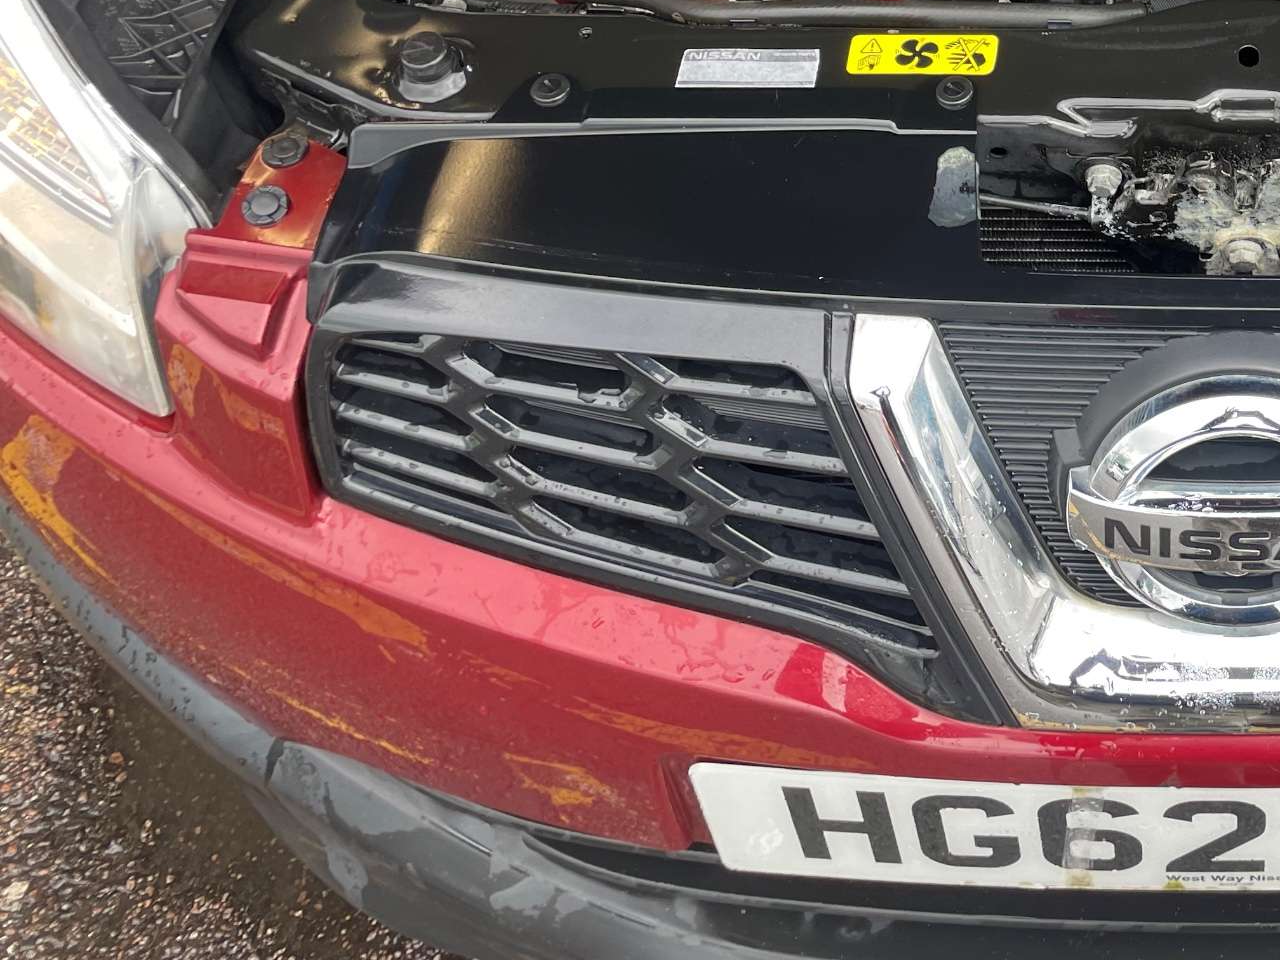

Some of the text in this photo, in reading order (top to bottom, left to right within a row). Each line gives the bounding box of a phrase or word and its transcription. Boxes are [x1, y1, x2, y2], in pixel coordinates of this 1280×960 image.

[688, 50, 761, 61] NISSAN
[781, 785, 1266, 873] HG62
[1165, 874, 1206, 882] West
[1210, 874, 1244, 883] Way
